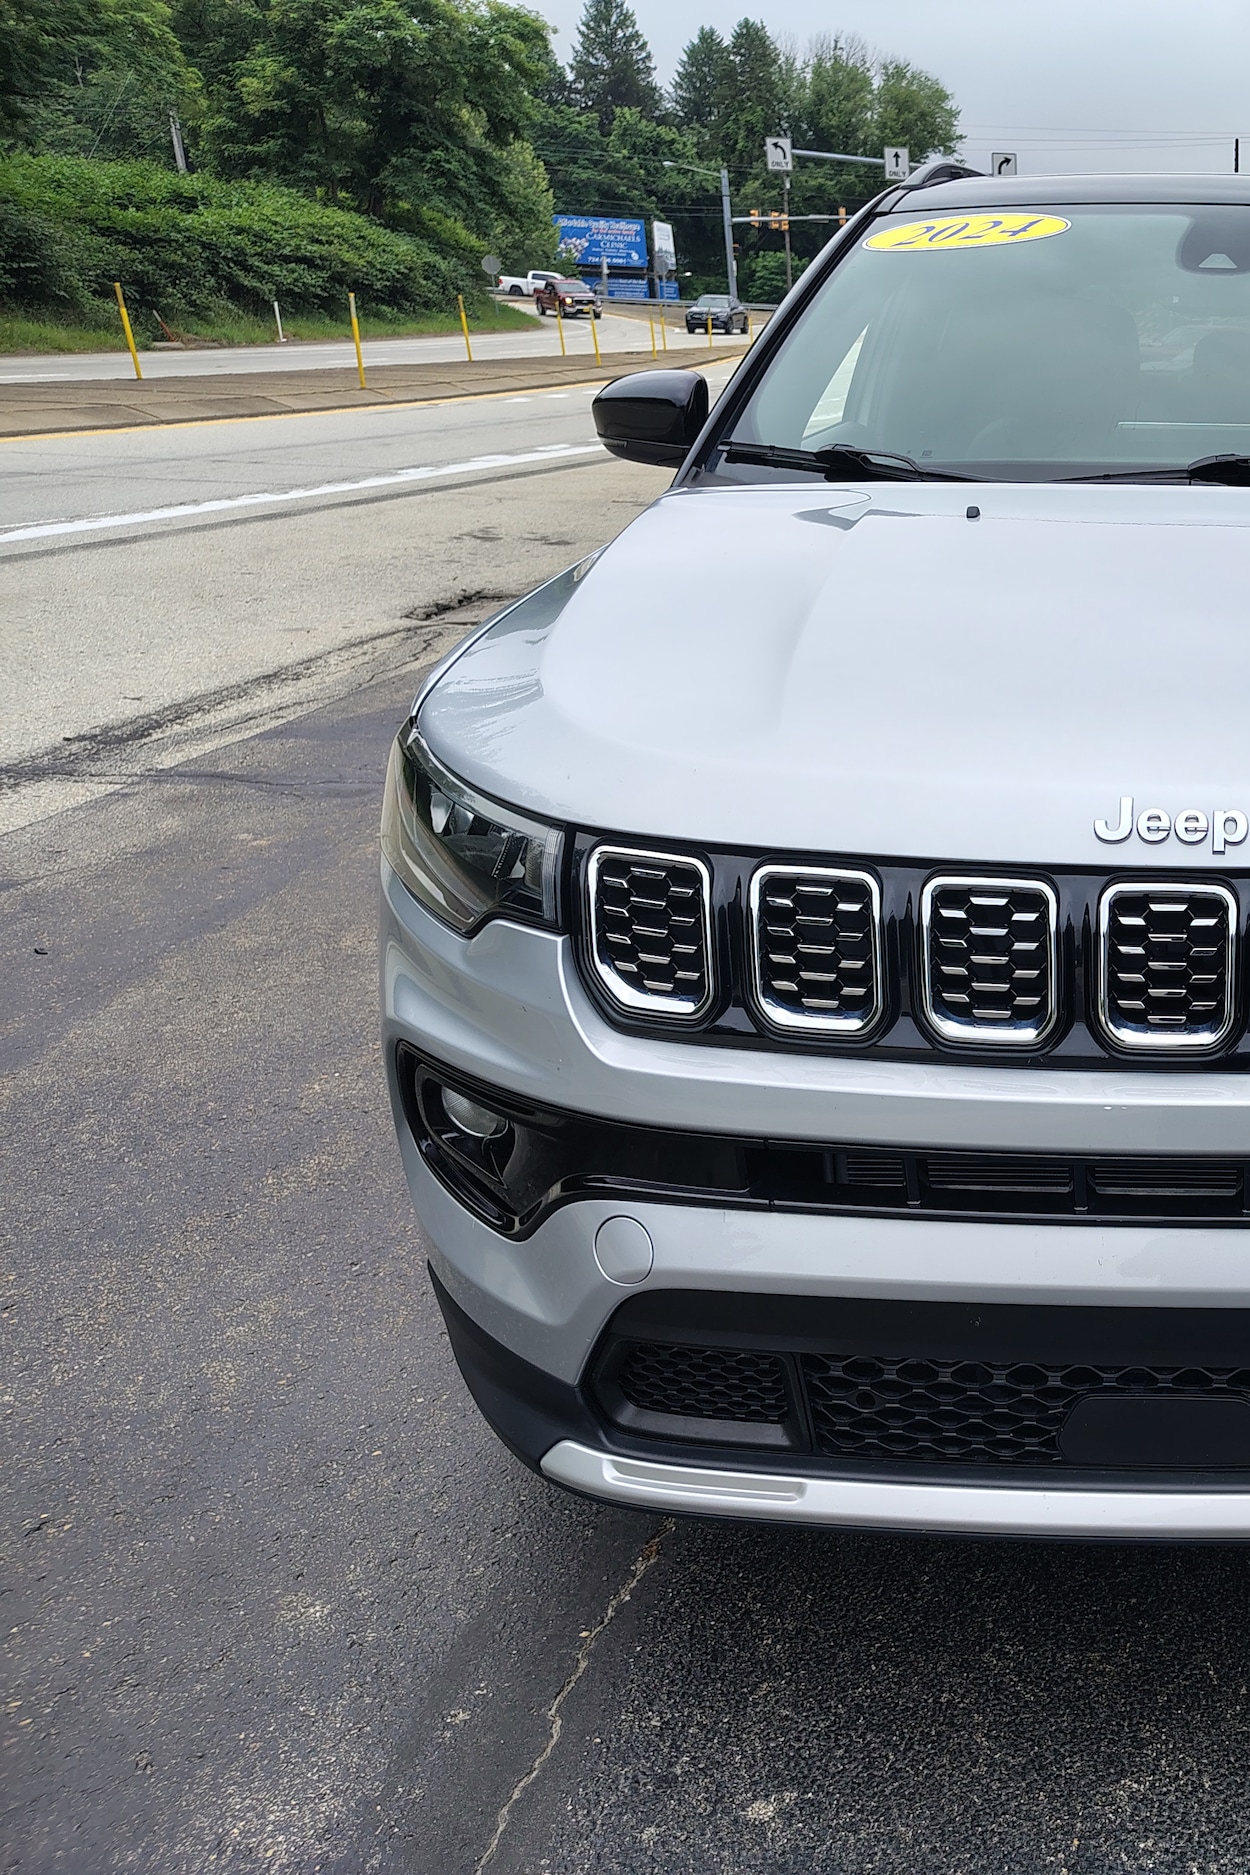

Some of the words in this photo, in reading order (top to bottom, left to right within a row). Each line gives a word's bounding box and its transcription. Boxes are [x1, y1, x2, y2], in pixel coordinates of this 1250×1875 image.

[771, 161, 790, 169] ONLY
[888, 170, 907, 178] ONLY
[889, 218, 1046, 248] 2024
[1093, 796, 1250, 856] Jeep
